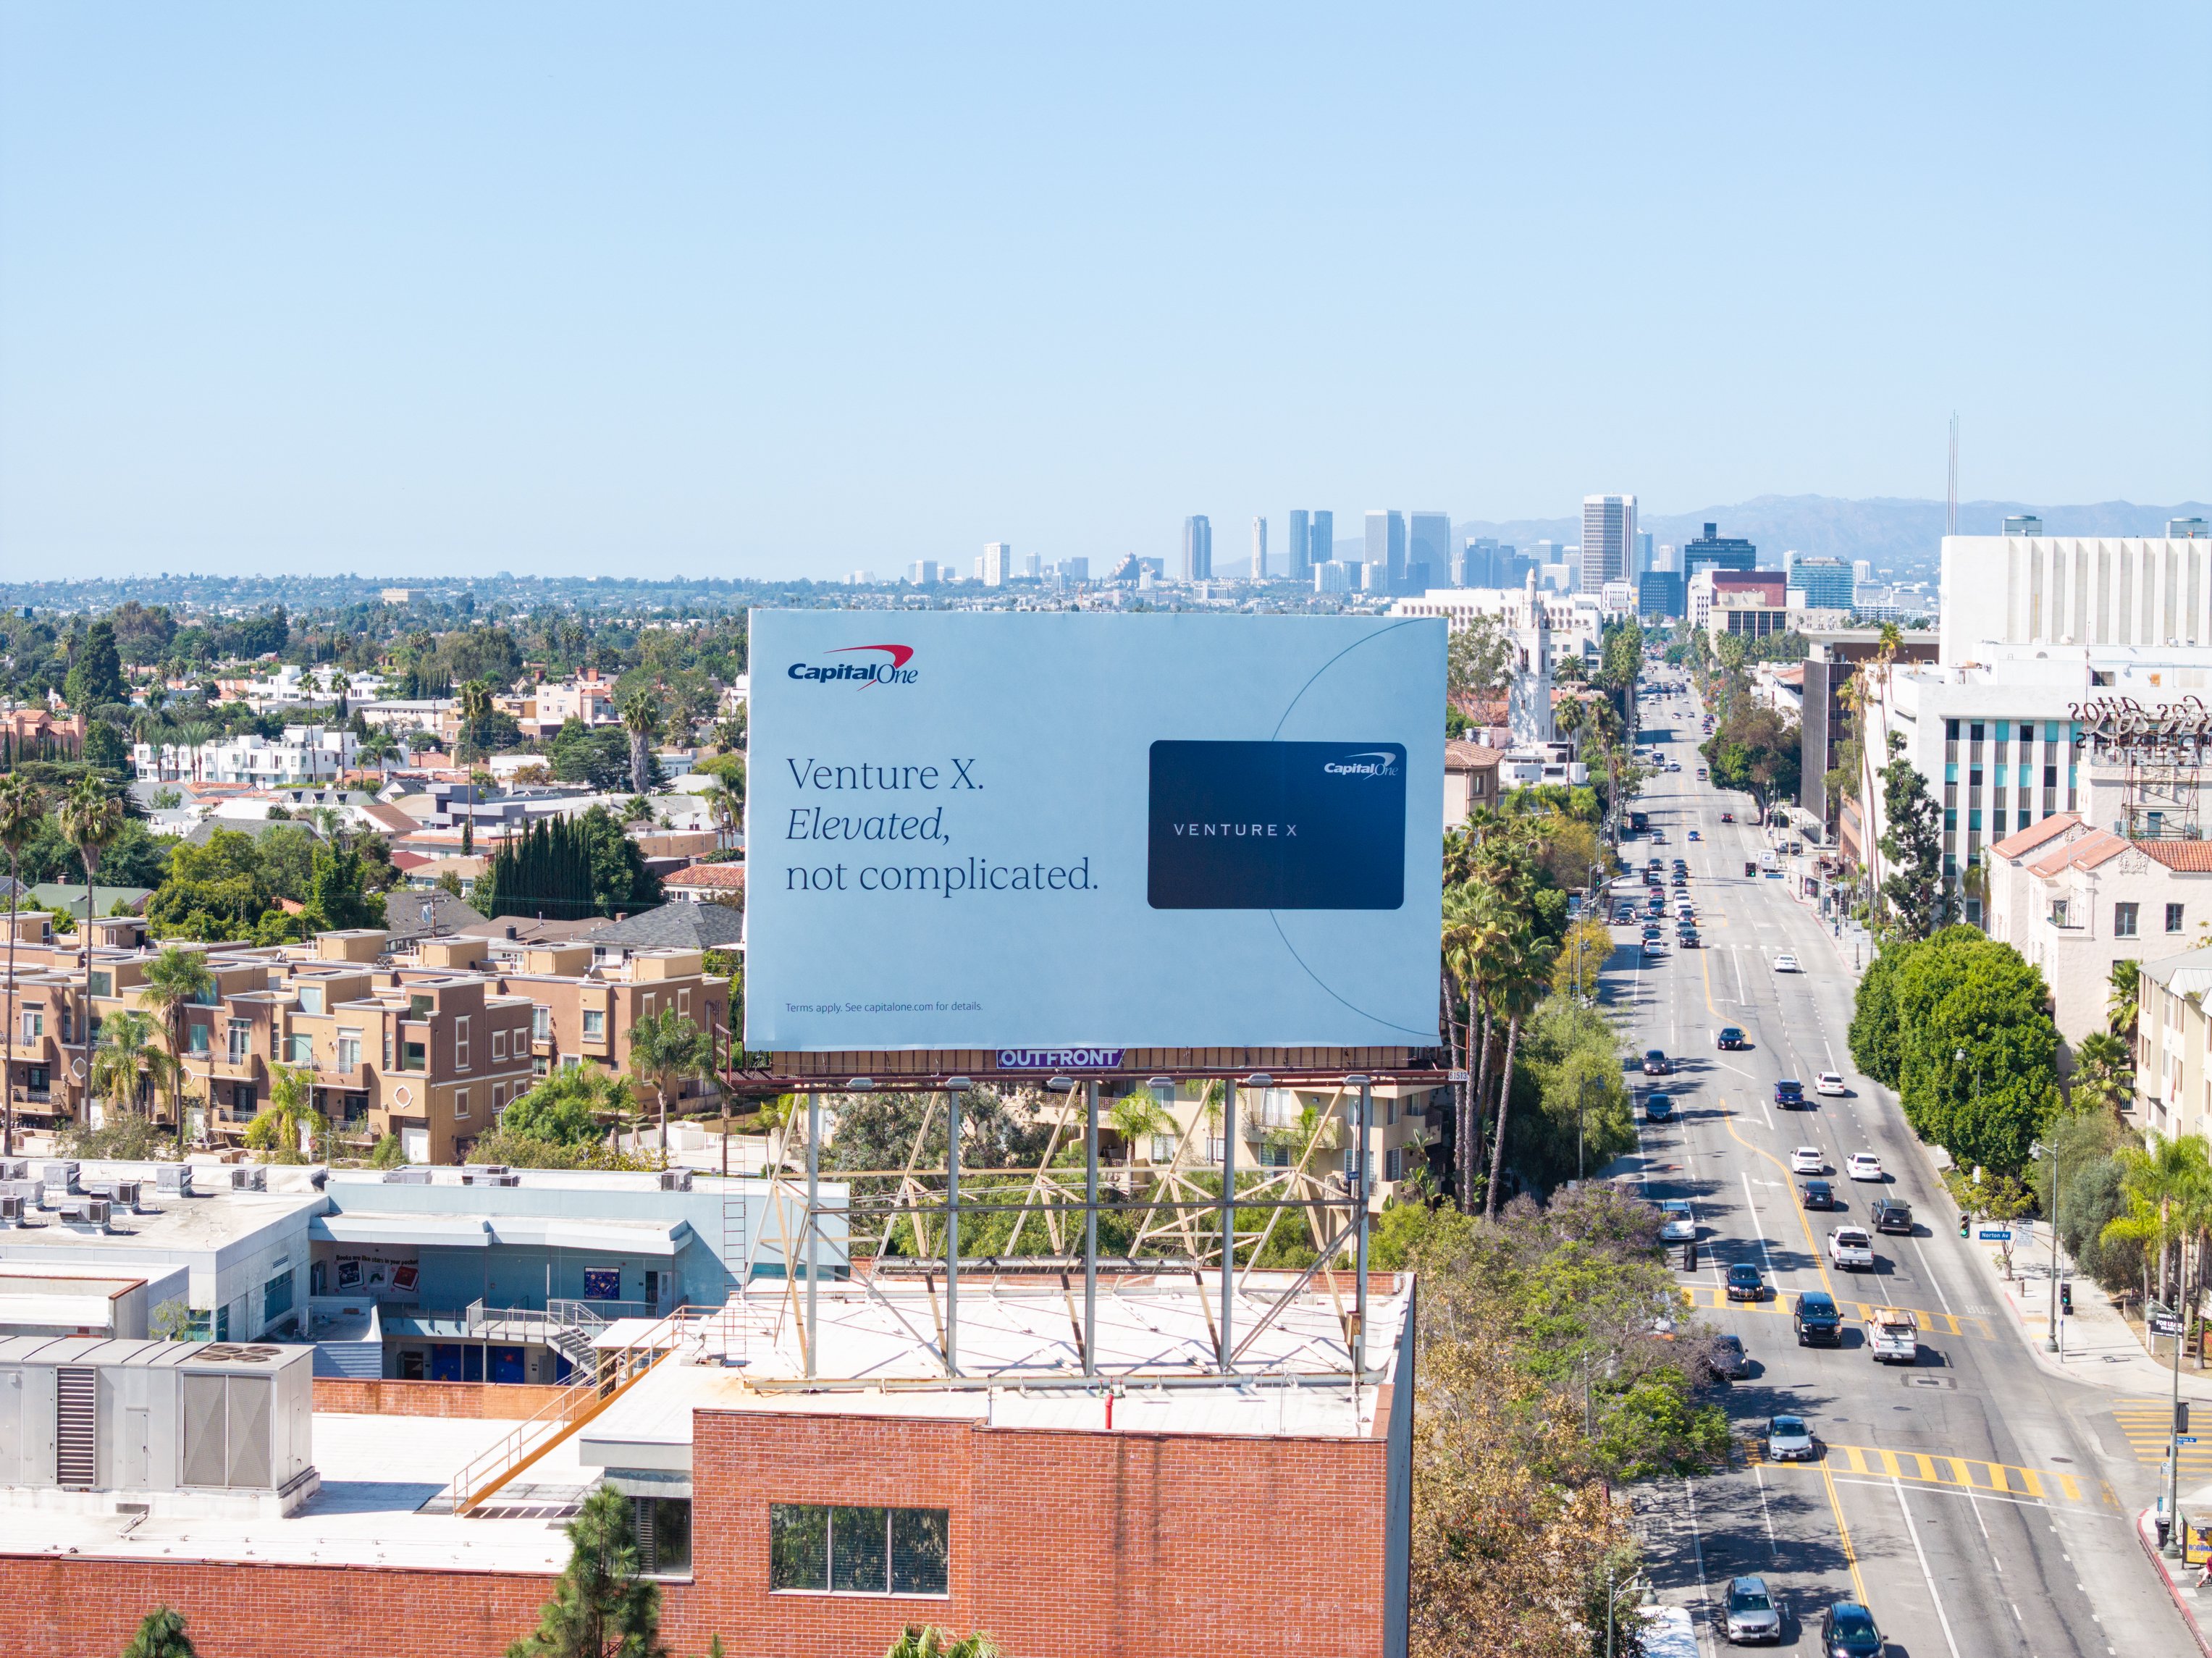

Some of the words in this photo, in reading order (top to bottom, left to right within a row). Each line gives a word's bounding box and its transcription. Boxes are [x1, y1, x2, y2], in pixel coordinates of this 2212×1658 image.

[2080, 701, 2149, 738] Los
[786, 758, 939, 790] Venture
[949, 758, 984, 790] X.
[786, 807, 950, 846] Elevated,
[1173, 824, 1278, 836] VENTURE
[1286, 824, 1298, 836] X
[786, 863, 848, 891] not
[859, 857, 1098, 899] complicated.
[786, 1003, 814, 1012] Terms
[816, 1003, 843, 1014] apply.
[845, 1003, 862, 1012] See
[865, 1002, 933, 1014] capitalone.com
[935, 1001, 949, 1011] for
[951, 1001, 983, 1011] details.
[1001, 1049, 1119, 1066] OUTFRONT
